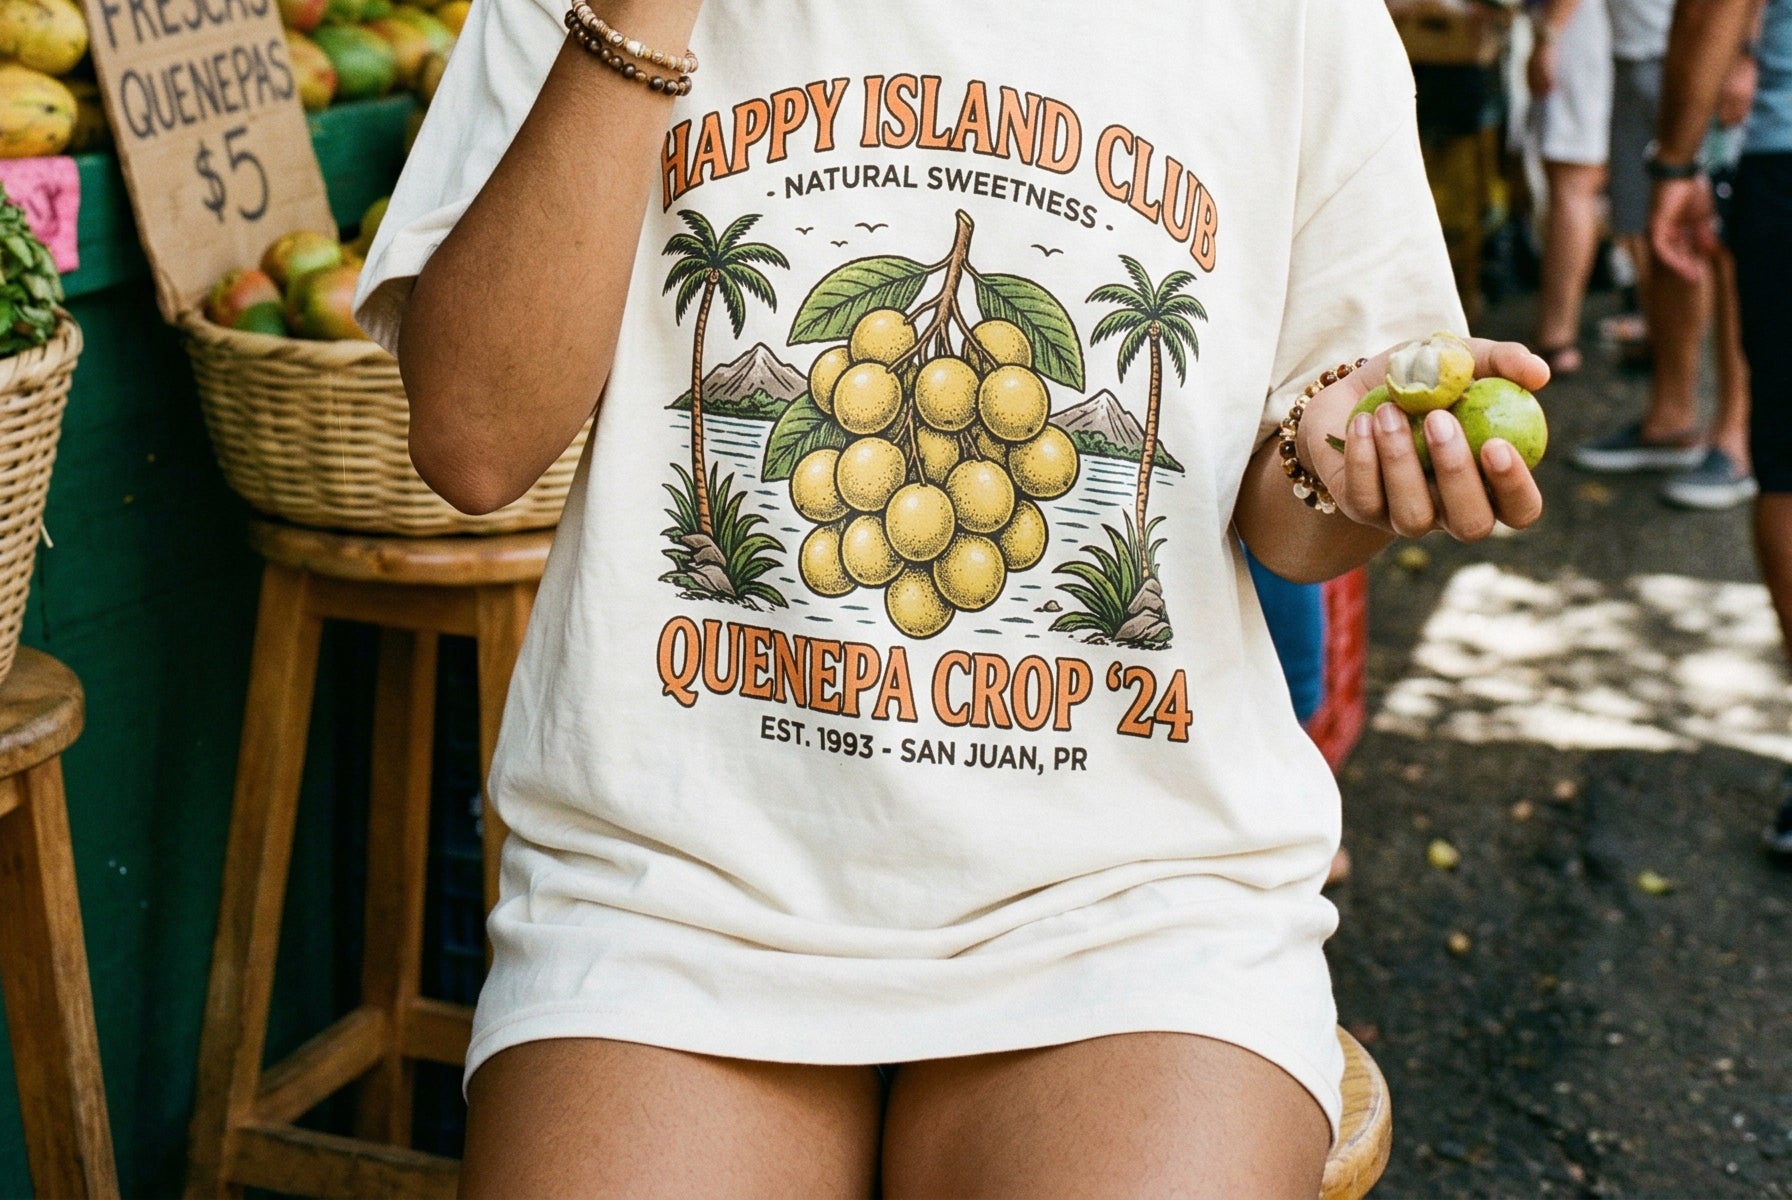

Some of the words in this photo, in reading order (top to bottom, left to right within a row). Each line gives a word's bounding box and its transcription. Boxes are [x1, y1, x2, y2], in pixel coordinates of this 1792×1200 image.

[119, 38, 296, 140] QUENEPAS
[195, 126, 269, 223] $5
[661, 77, 849, 214] HAPPY
[861, 73, 1082, 175] ISLAND
[1095, 123, 1219, 273] CLUB
[785, 165, 918, 199] NATURAL
[927, 166, 1098, 229] SWEETNESS
[656, 615, 918, 723] QUENEPA
[931, 649, 1094, 732] CROP
[760, 714, 810, 748] EST.
[817, 726, 874, 760] 1993
[900, 738, 956, 767] SAN
[964, 743, 1044, 776] JUAN,
[1053, 745, 1088, 772] PR
